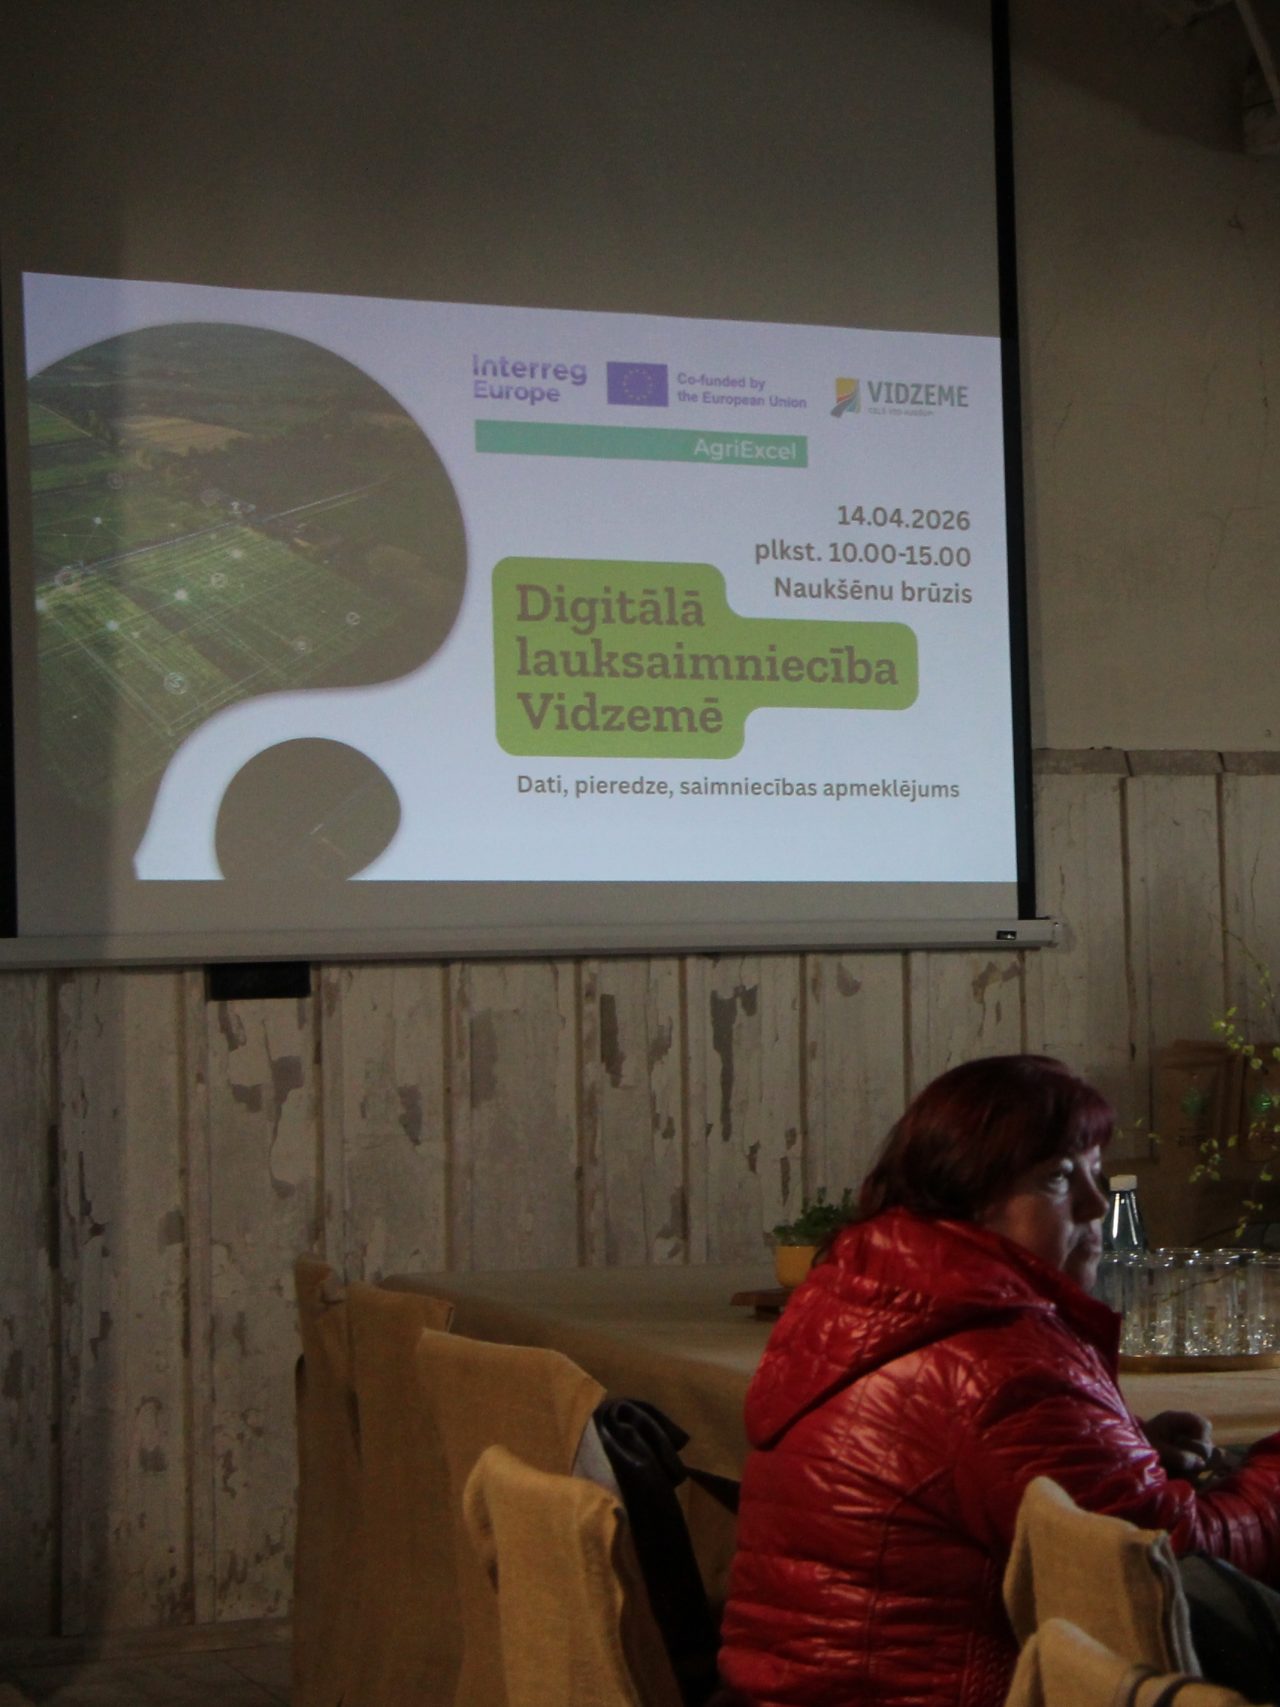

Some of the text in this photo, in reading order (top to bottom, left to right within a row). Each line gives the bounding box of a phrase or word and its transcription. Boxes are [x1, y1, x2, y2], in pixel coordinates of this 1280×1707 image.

[472, 354, 587, 386] Interreg
[677, 372, 766, 391] Co-funded by
[473, 380, 561, 405] Europe
[677, 390, 807, 409] the European Union
[867, 381, 969, 408] VIDZEME
[694, 438, 797, 461] AgriExcel
[837, 505, 971, 531] 14.04.2026
[755, 539, 971, 567] plkst. 10.00-15.00
[774, 576, 973, 603] Naukšēnu brūzis
[516, 583, 705, 635] Digitālā
[516, 636, 899, 685] lauksaimniecība
[517, 692, 723, 733] Vidzemē
[517, 775, 960, 803] Dati, pieredze, saimniecības apmeklējums
